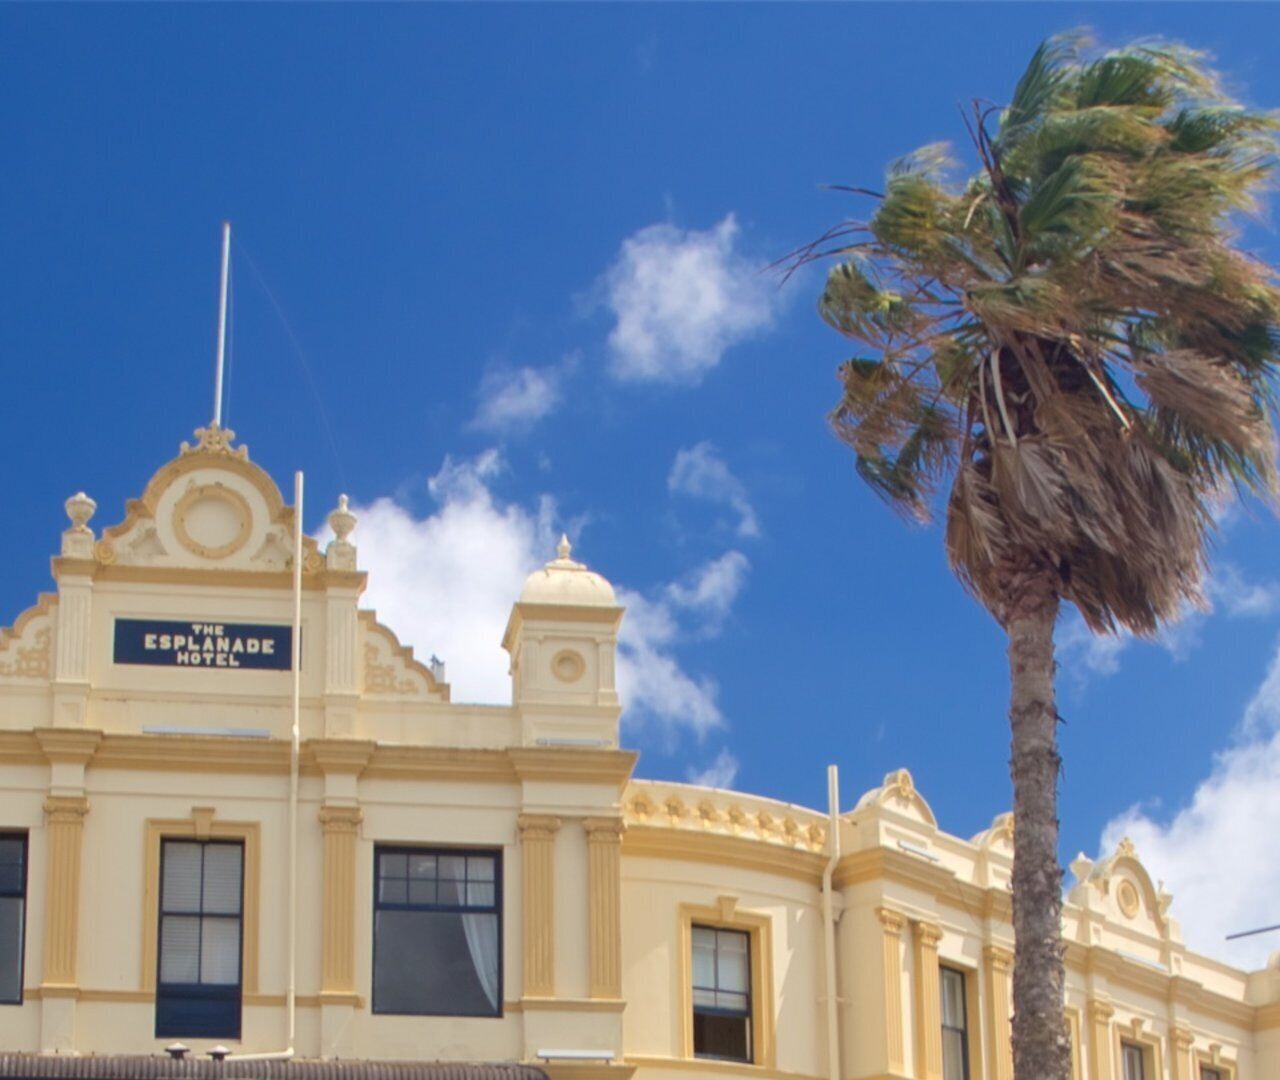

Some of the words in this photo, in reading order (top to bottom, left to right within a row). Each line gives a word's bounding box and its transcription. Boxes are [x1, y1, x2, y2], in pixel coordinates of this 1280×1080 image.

[192, 624, 224, 636] THE
[144, 634, 274, 655] ESPLANADE
[177, 652, 240, 667] HOTEL
